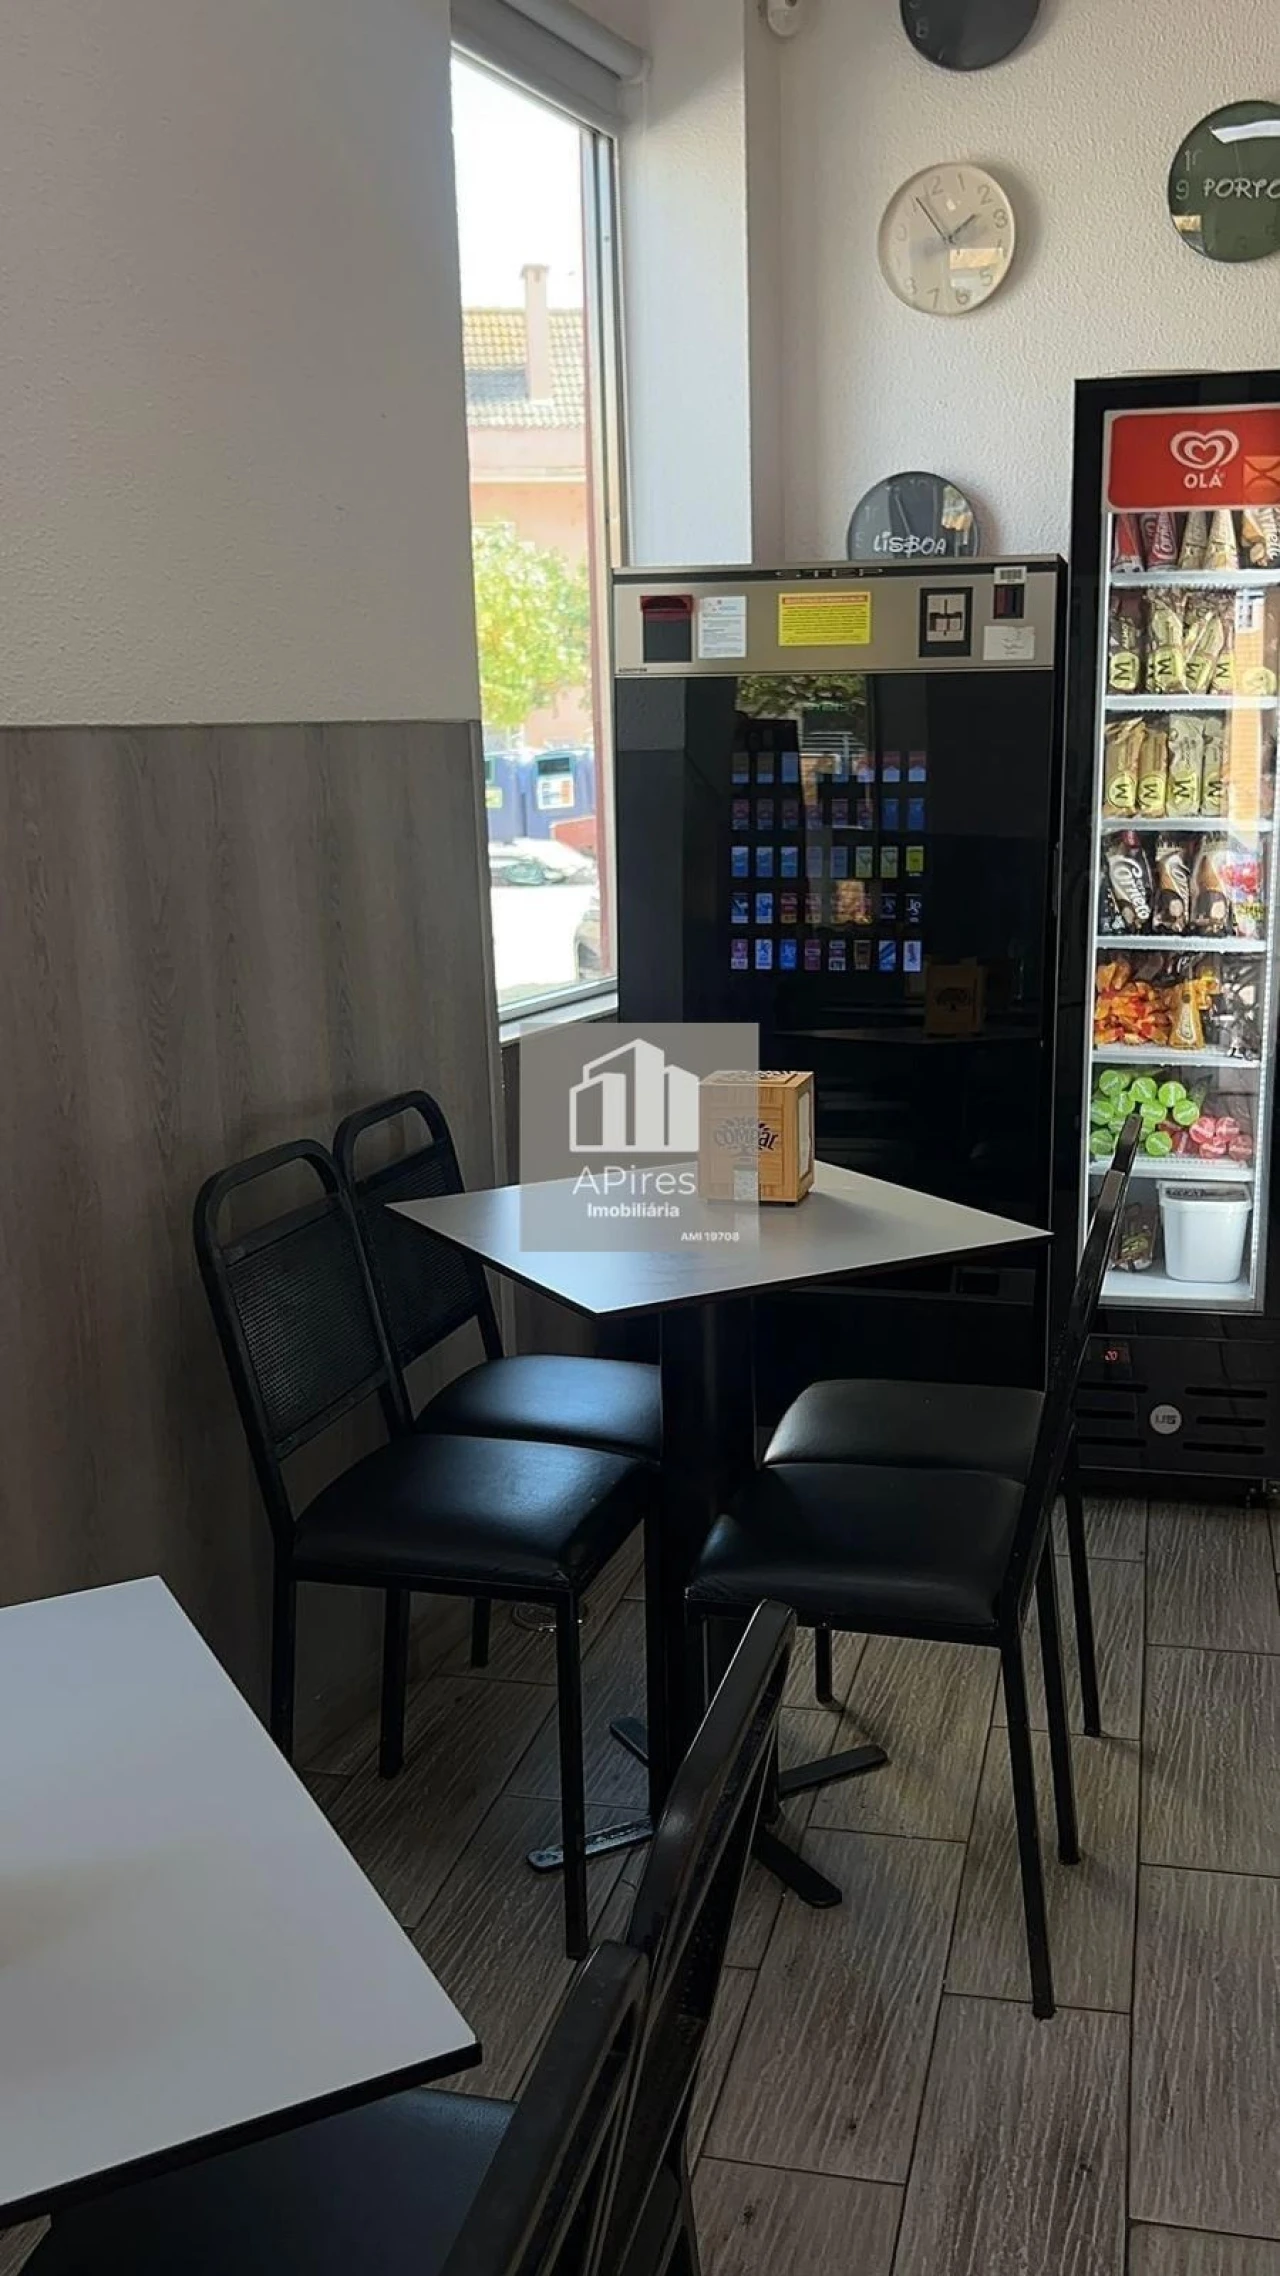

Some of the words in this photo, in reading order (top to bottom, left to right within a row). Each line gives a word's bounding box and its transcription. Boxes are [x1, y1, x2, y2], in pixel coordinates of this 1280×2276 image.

[977, 183, 994, 206] 2
[1175, 179, 1190, 201] 9
[992, 207, 1009, 229] 3
[1184, 468, 1222, 489] OLÁ
